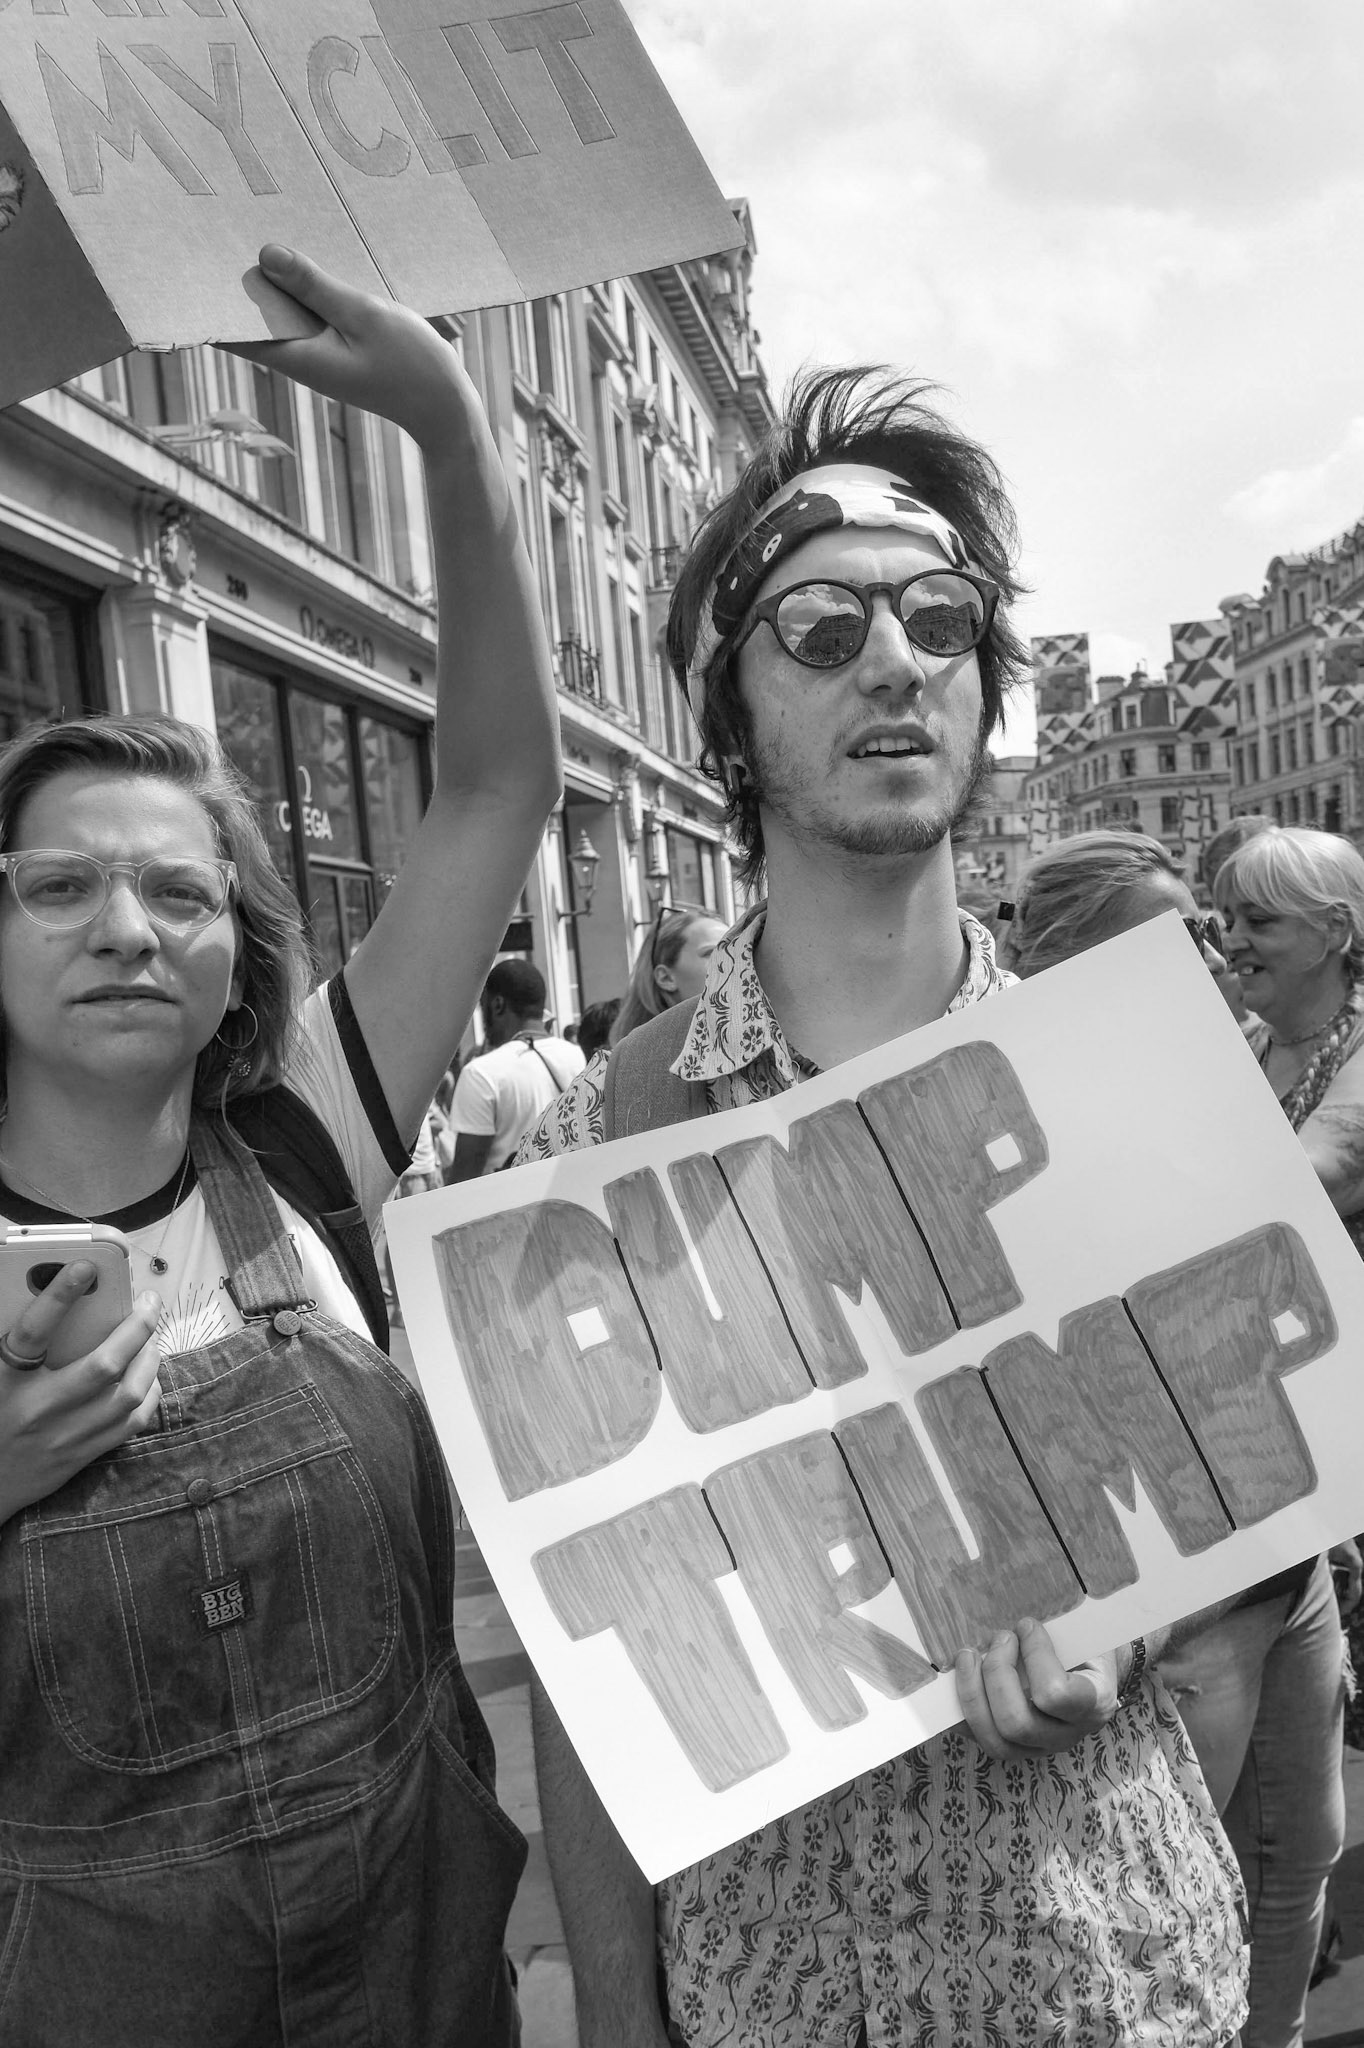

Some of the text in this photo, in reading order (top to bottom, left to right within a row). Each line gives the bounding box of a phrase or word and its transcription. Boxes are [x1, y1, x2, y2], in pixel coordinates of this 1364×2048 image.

[34, 1, 617, 197] MY CLIT
[431, 1040, 1050, 1503] DUMP
[201, 1583, 242, 1611] BIG
[530, 1221, 1340, 1794] TRUMP
[205, 1597, 245, 1625] BEN
